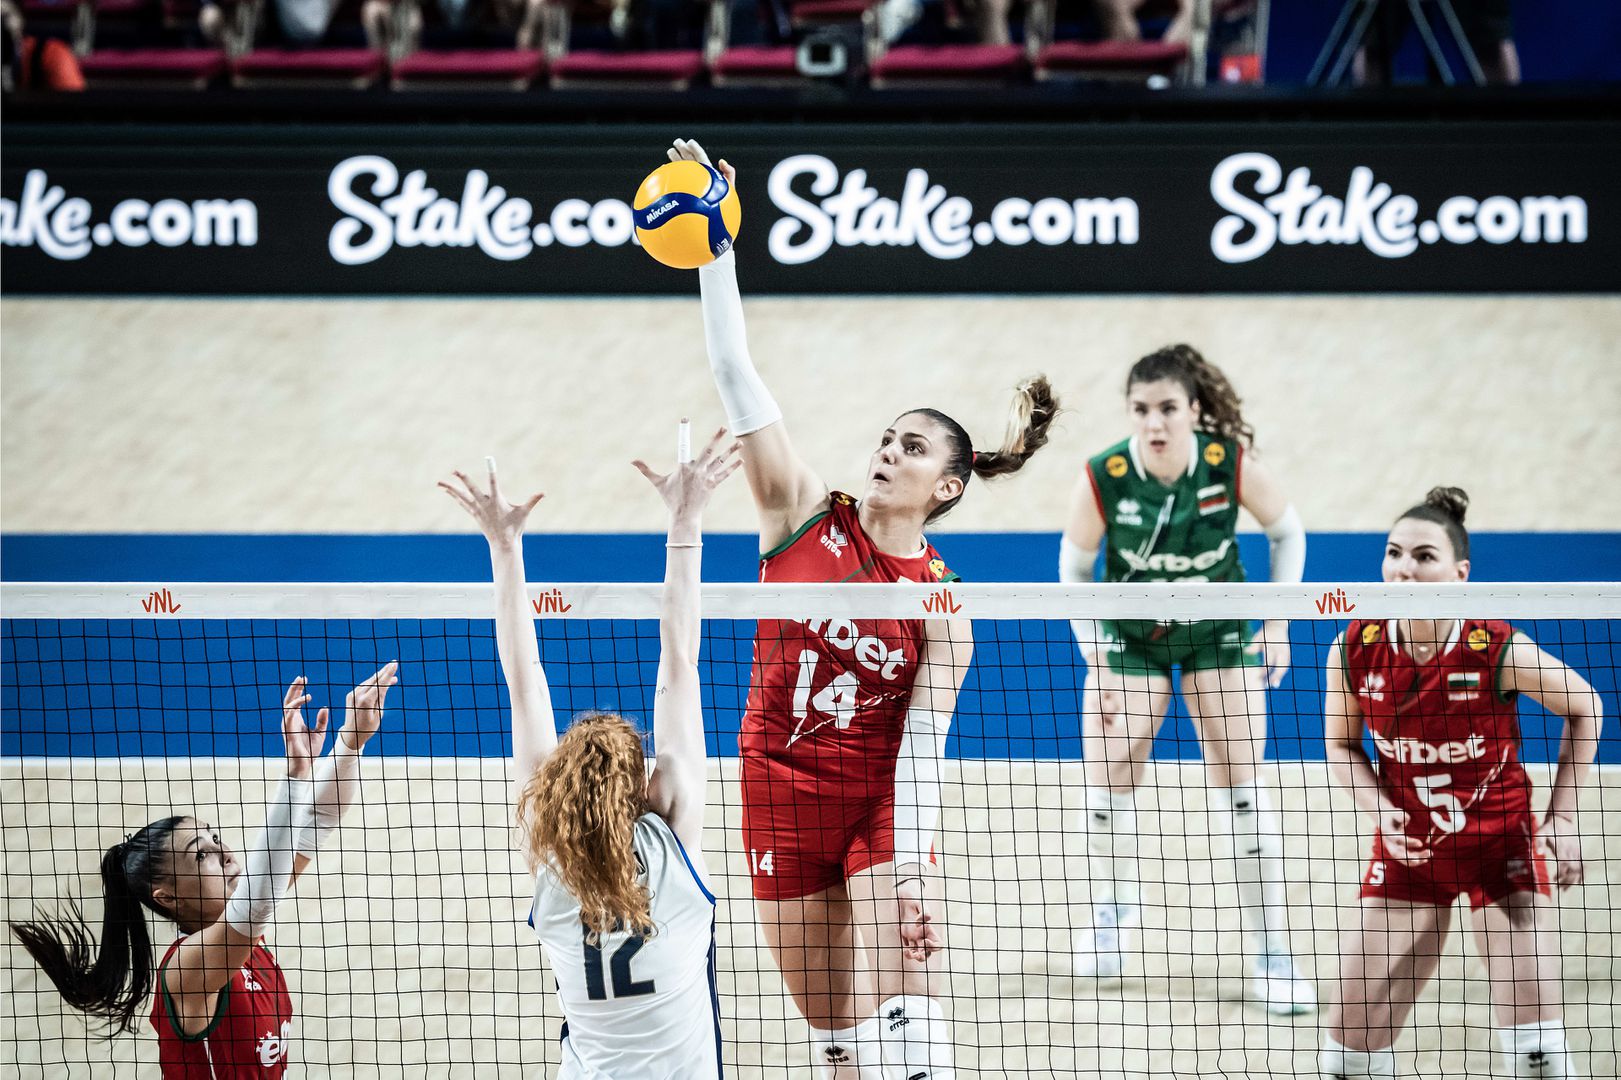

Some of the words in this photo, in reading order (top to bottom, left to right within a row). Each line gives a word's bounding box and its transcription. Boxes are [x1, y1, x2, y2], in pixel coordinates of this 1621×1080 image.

[328, 155, 642, 265] Stake.co
[767, 154, 1140, 265] Stake.com
[1210, 152, 1588, 263] Stake.com
[792, 619, 907, 680] bet
[793, 649, 860, 728] 14
[1412, 773, 1466, 833] 5
[751, 849, 774, 875] 14
[1369, 861, 1387, 886] 5
[581, 906, 656, 1000] 12
